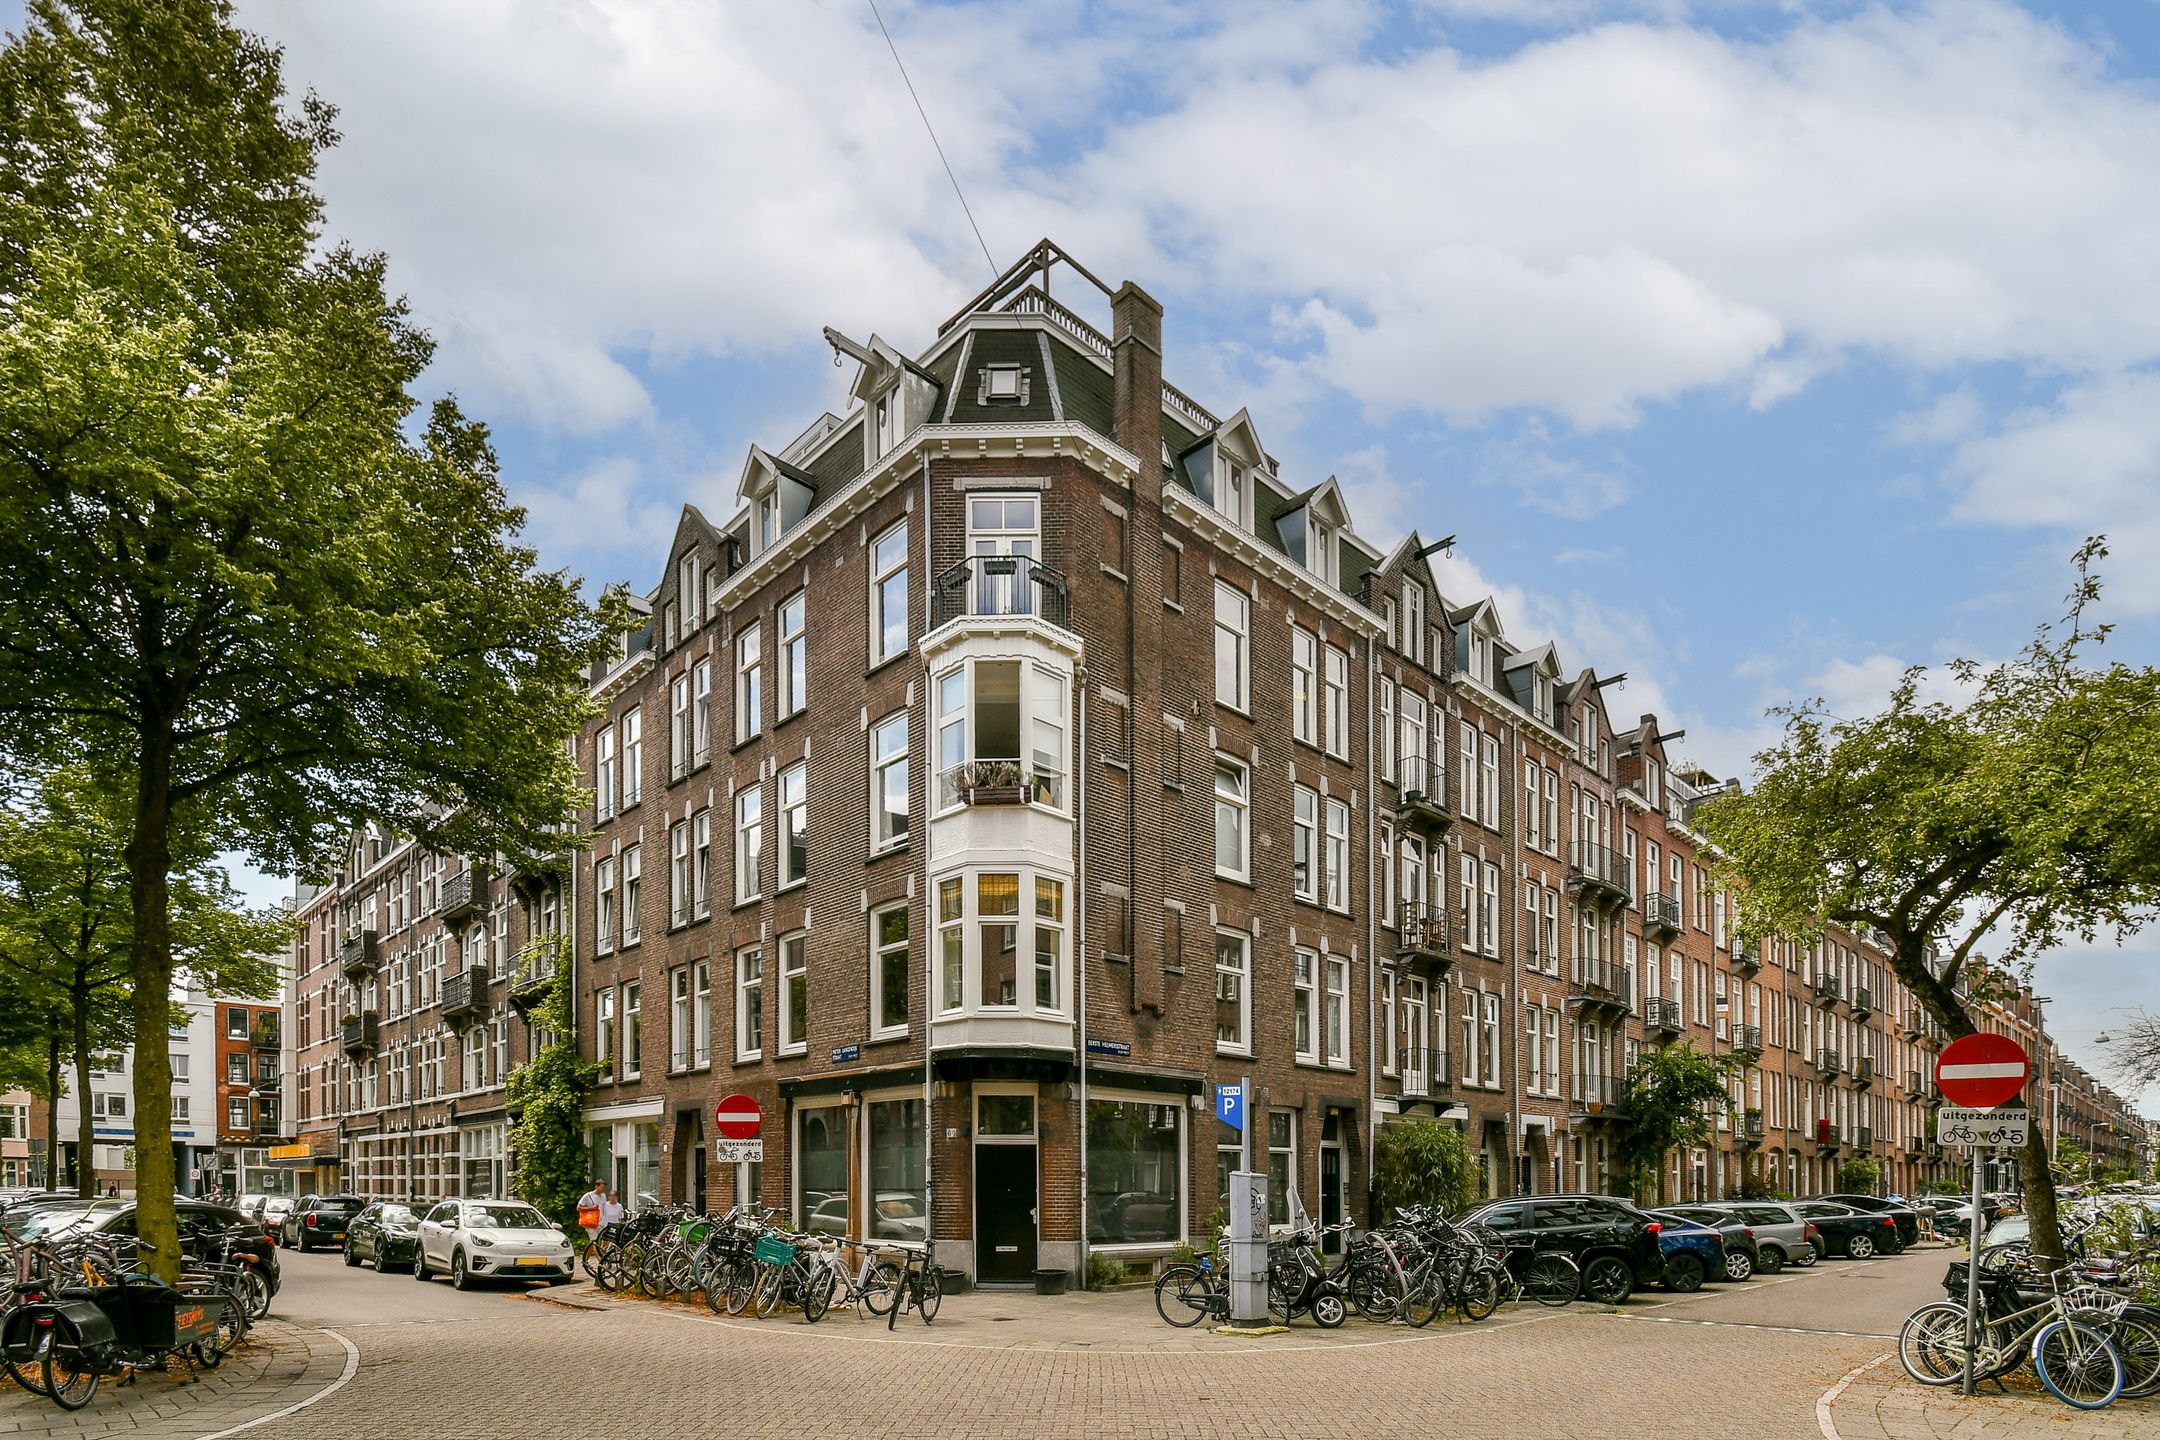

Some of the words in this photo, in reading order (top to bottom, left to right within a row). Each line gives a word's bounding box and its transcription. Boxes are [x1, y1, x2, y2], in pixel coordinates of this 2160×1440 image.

[1224, 1097, 1236, 1116] P
[1942, 1111, 2026, 1122] uitgezonderd
[718, 1140, 761, 1148] uitgezonderd
